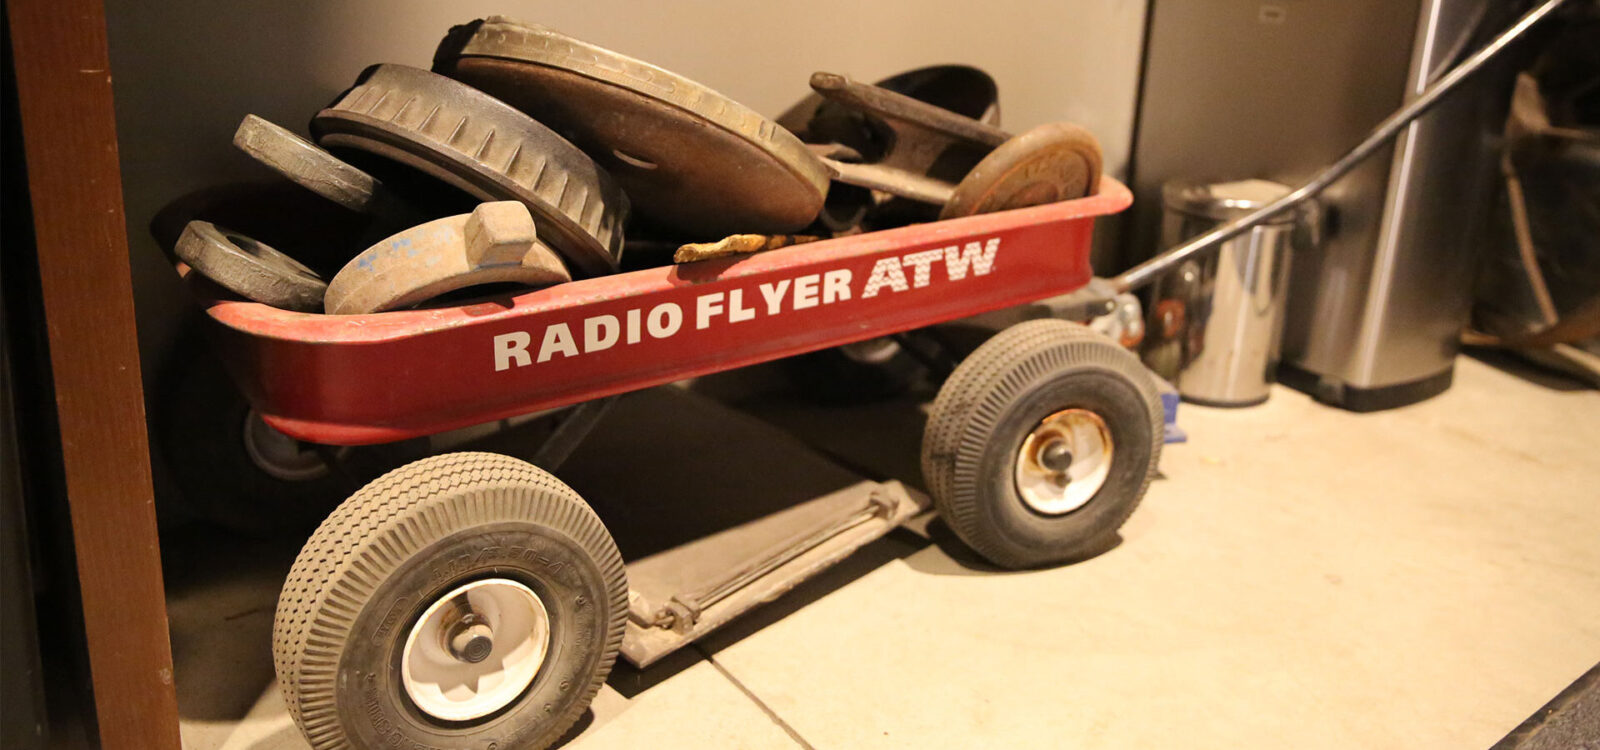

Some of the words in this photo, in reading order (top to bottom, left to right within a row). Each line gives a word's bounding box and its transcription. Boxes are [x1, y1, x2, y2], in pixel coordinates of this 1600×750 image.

[493, 302, 683, 372] RADIO
[696, 268, 853, 330] FLYER
[861, 237, 1001, 299] ATW
